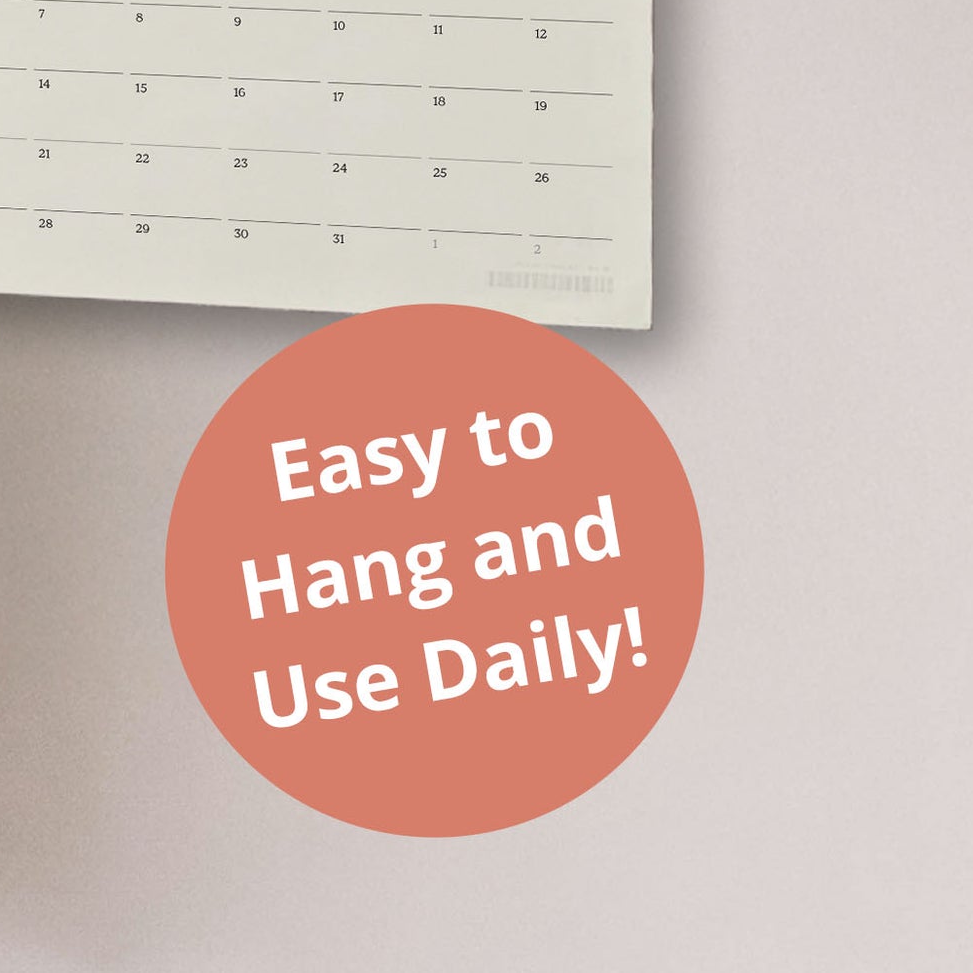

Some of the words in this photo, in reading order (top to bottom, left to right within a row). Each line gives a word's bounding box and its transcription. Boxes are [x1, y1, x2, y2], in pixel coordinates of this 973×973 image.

[38, 8, 46, 19] 7
[135, 12, 144, 24] 8
[233, 16, 242, 27] 9
[332, 20, 346, 31] 10
[432, 24, 443, 35] 11
[534, 28, 548, 40] 12
[38, 78, 51, 89] 14
[134, 82, 148, 94] 15
[233, 86, 246, 98] 16
[332, 91, 345, 103] 17
[432, 95, 447, 107] 18
[534, 100, 548, 112] 19
[38, 147, 51, 160] 21
[135, 152, 150, 164] 22
[233, 157, 249, 169] 23
[332, 162, 348, 174] 24
[432, 167, 448, 179] 25
[534, 172, 550, 184] 26
[38, 218, 54, 229] 28
[135, 223, 151, 234] 29
[233, 228, 249, 240] 30
[332, 233, 345, 245] 31
[433, 239, 439, 249] 1
[533, 244, 542, 255] 2
